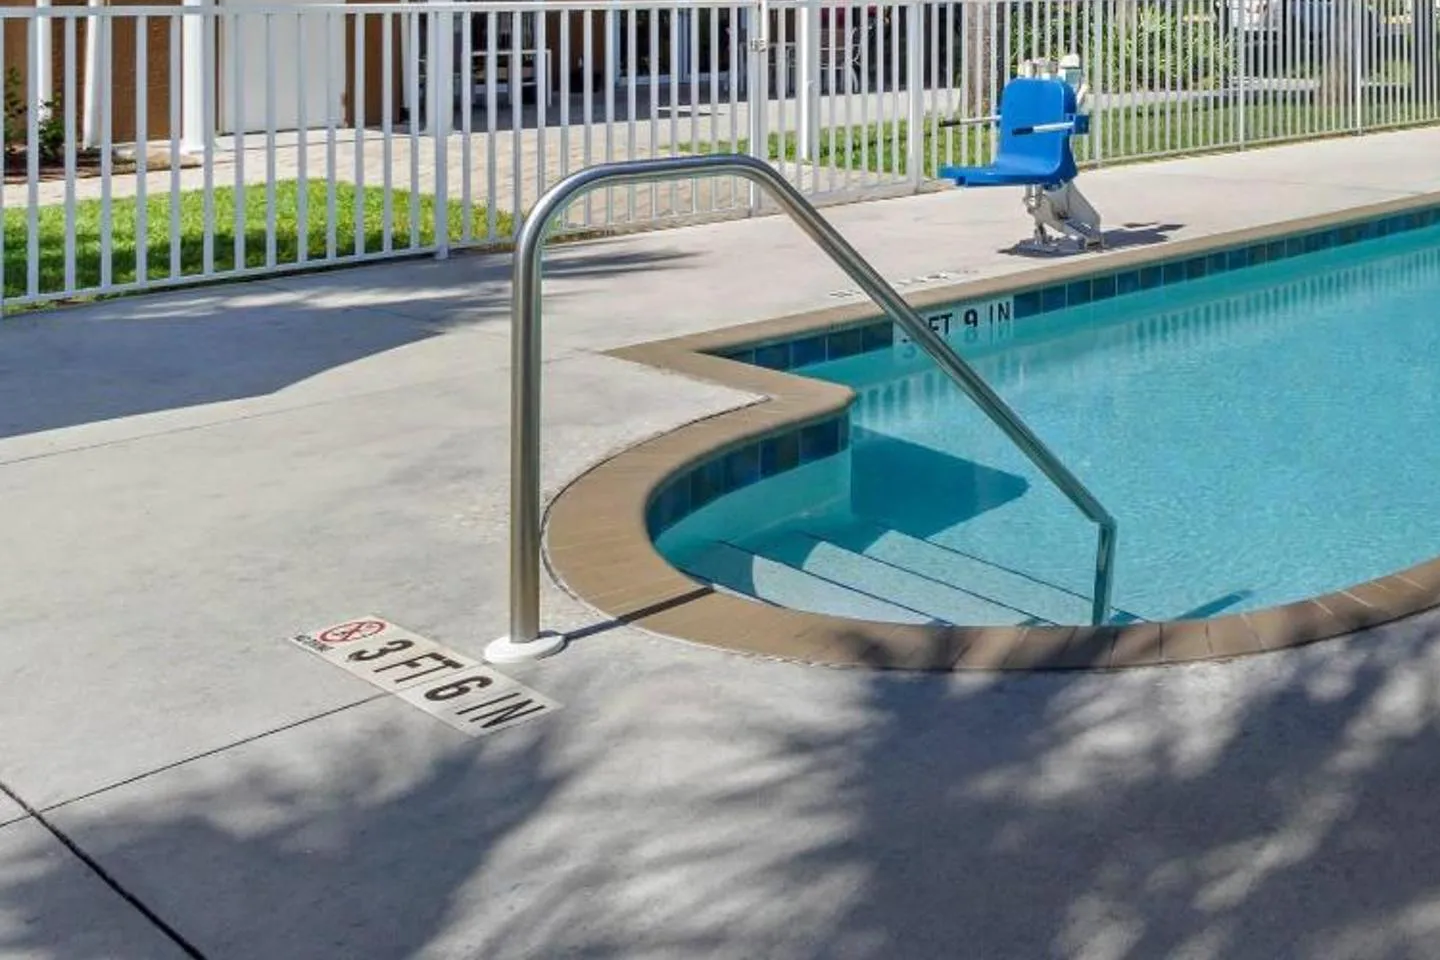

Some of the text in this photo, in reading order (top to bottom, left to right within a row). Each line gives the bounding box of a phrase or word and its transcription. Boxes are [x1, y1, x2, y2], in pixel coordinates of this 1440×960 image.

[963, 308, 978, 327] 9
[989, 301, 1011, 324] IN
[347, 638, 415, 662] 3
[372, 651, 466, 684] FT
[424, 675, 494, 701] 6
[454, 691, 547, 729] IN
